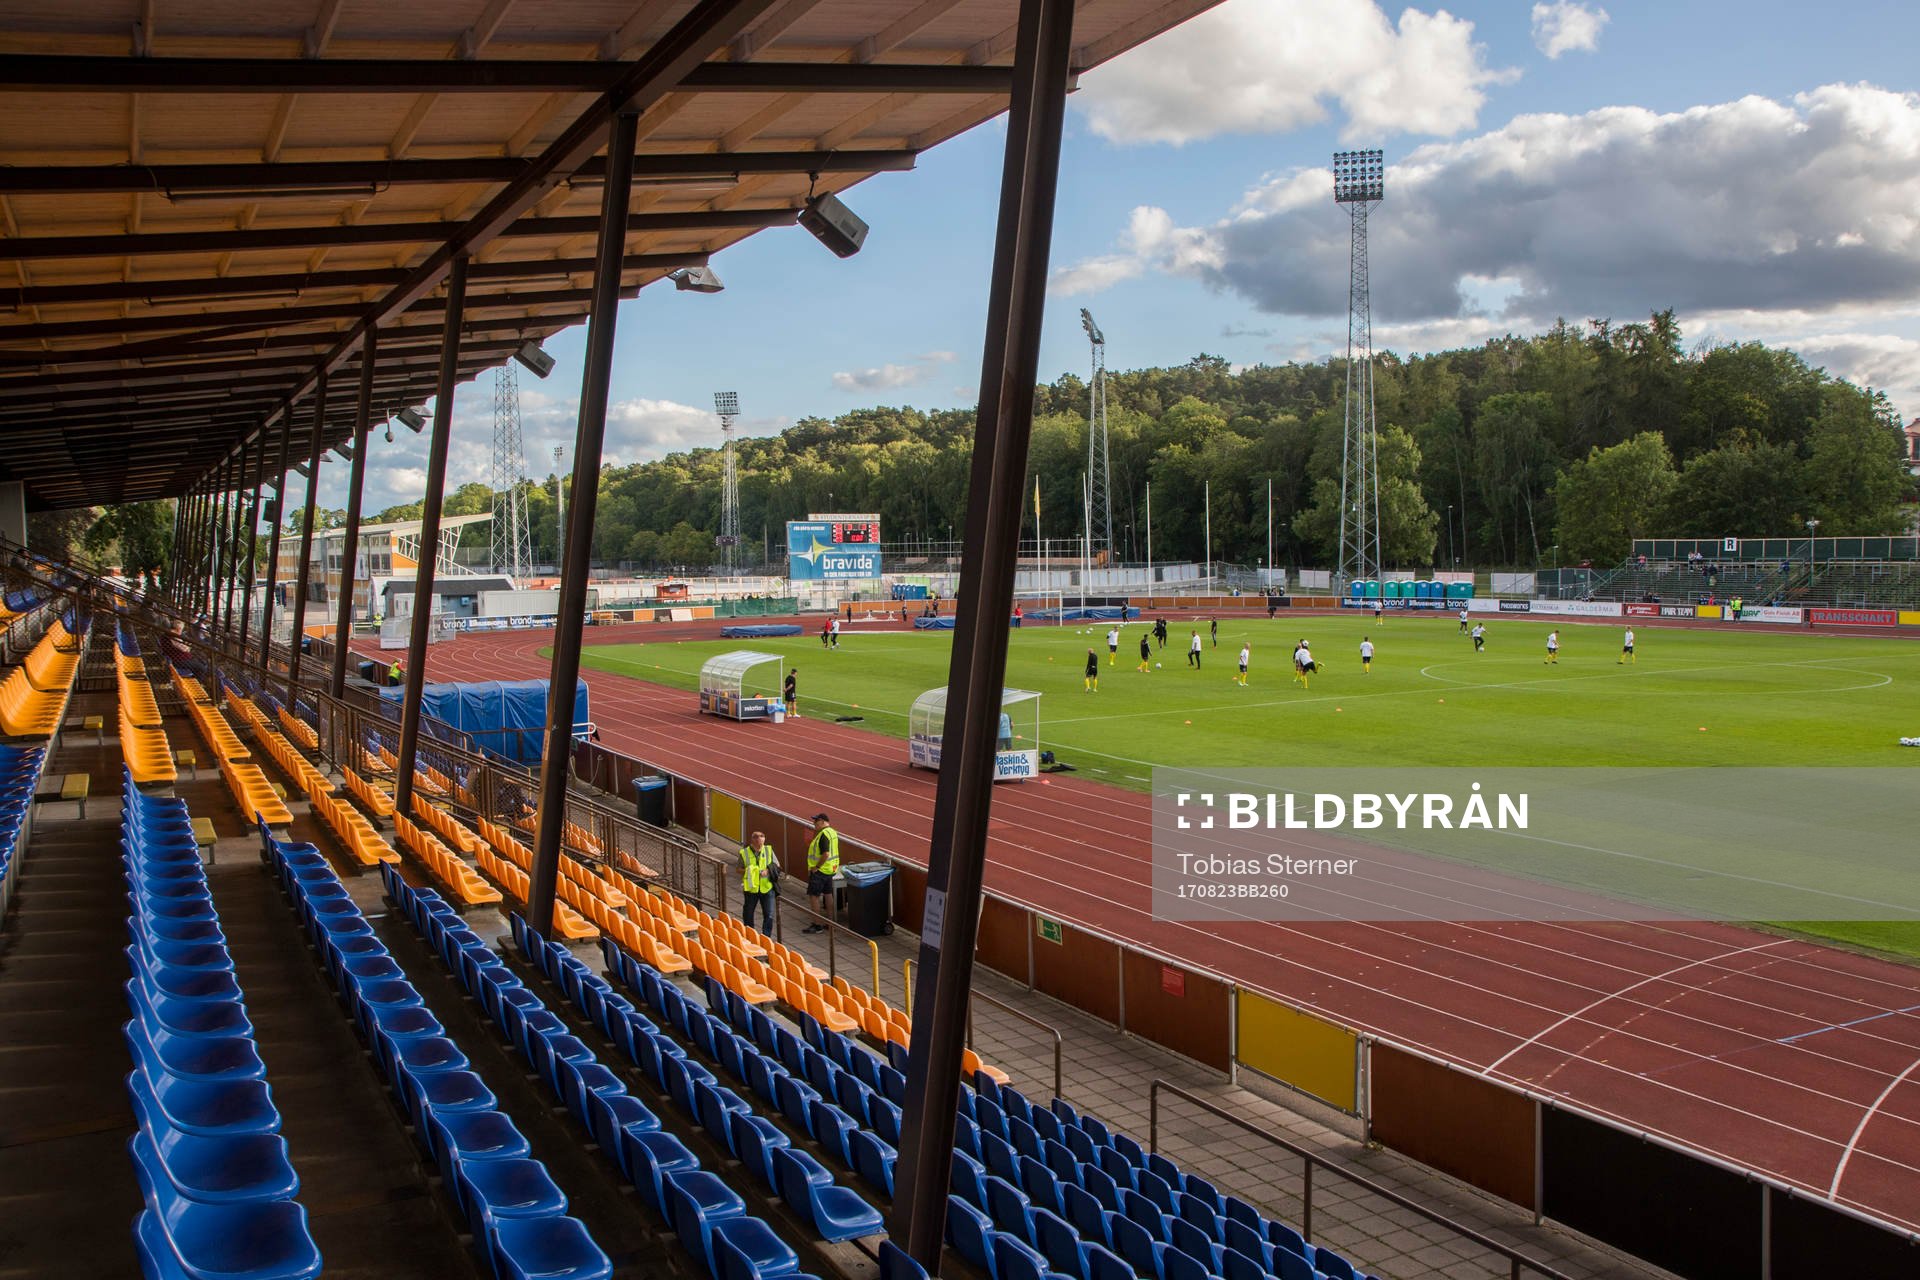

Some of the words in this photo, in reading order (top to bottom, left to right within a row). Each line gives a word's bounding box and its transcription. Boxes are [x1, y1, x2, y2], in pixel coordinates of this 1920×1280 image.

[1727, 539, 1734, 550] R
[823, 554, 873, 570] bravida
[1383, 598, 1404, 606] brand
[1447, 599, 1468, 607] brand
[1677, 607, 1693, 616] TEAM
[510, 616, 532, 625] brand
[1813, 612, 1892, 622] TRANSSCHAKT
[443, 619, 467, 630] brand
[998, 764, 1030, 775] Verktyg
